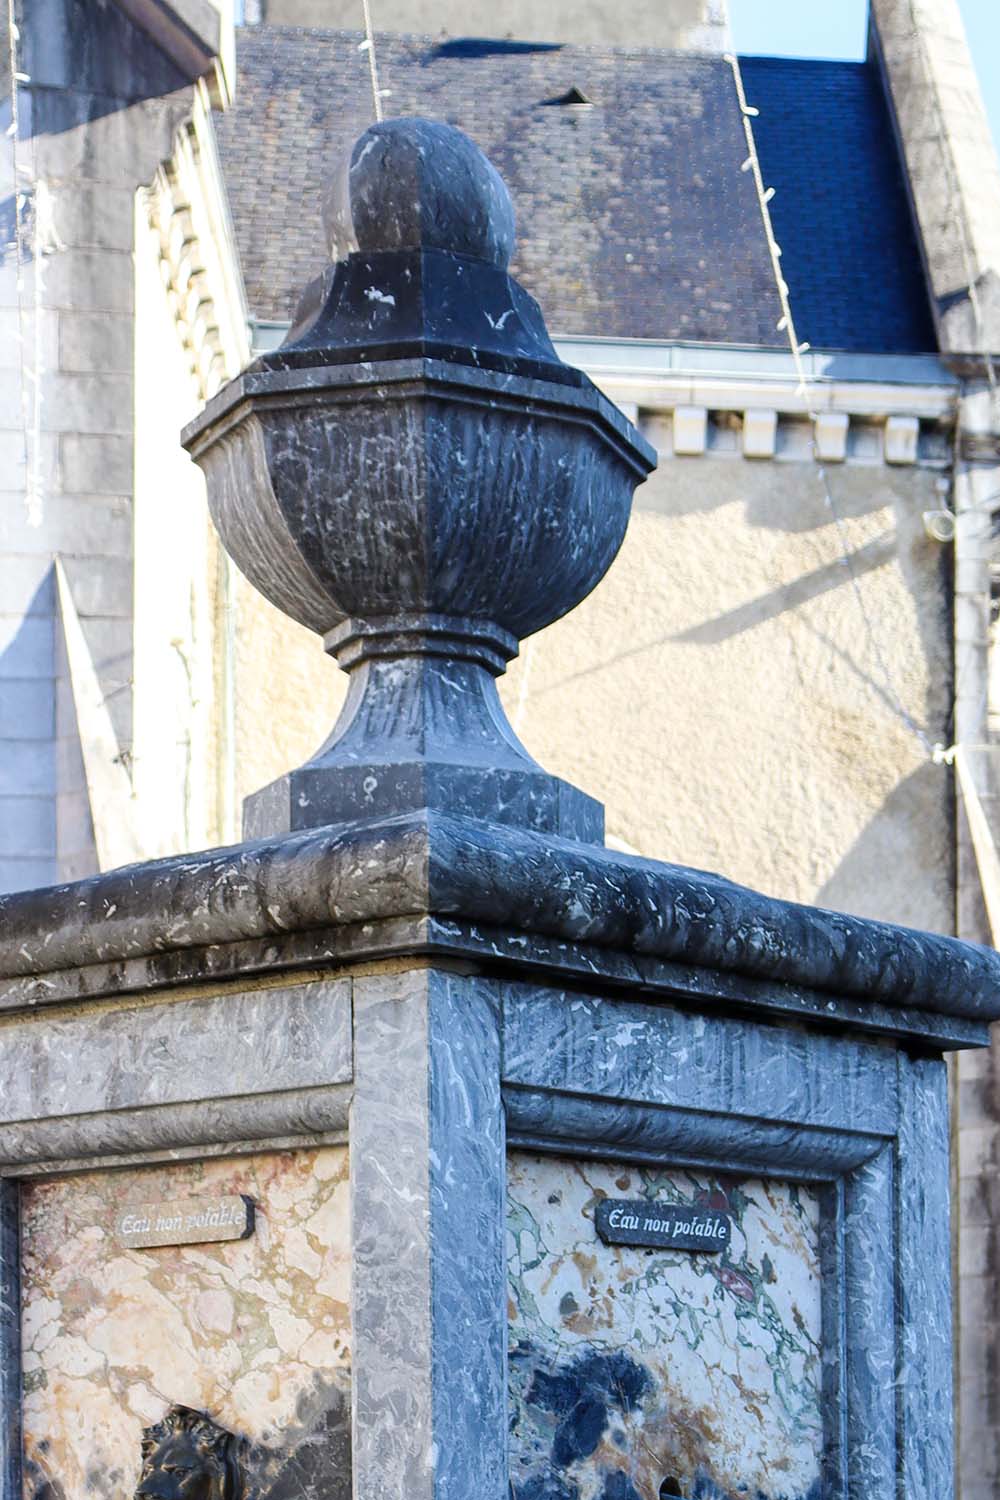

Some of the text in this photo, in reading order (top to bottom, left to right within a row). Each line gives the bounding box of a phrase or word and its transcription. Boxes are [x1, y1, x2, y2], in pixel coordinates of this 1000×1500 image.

[121, 1202, 243, 1234] Eau non potable
[608, 1209, 727, 1239] Eau non potable
